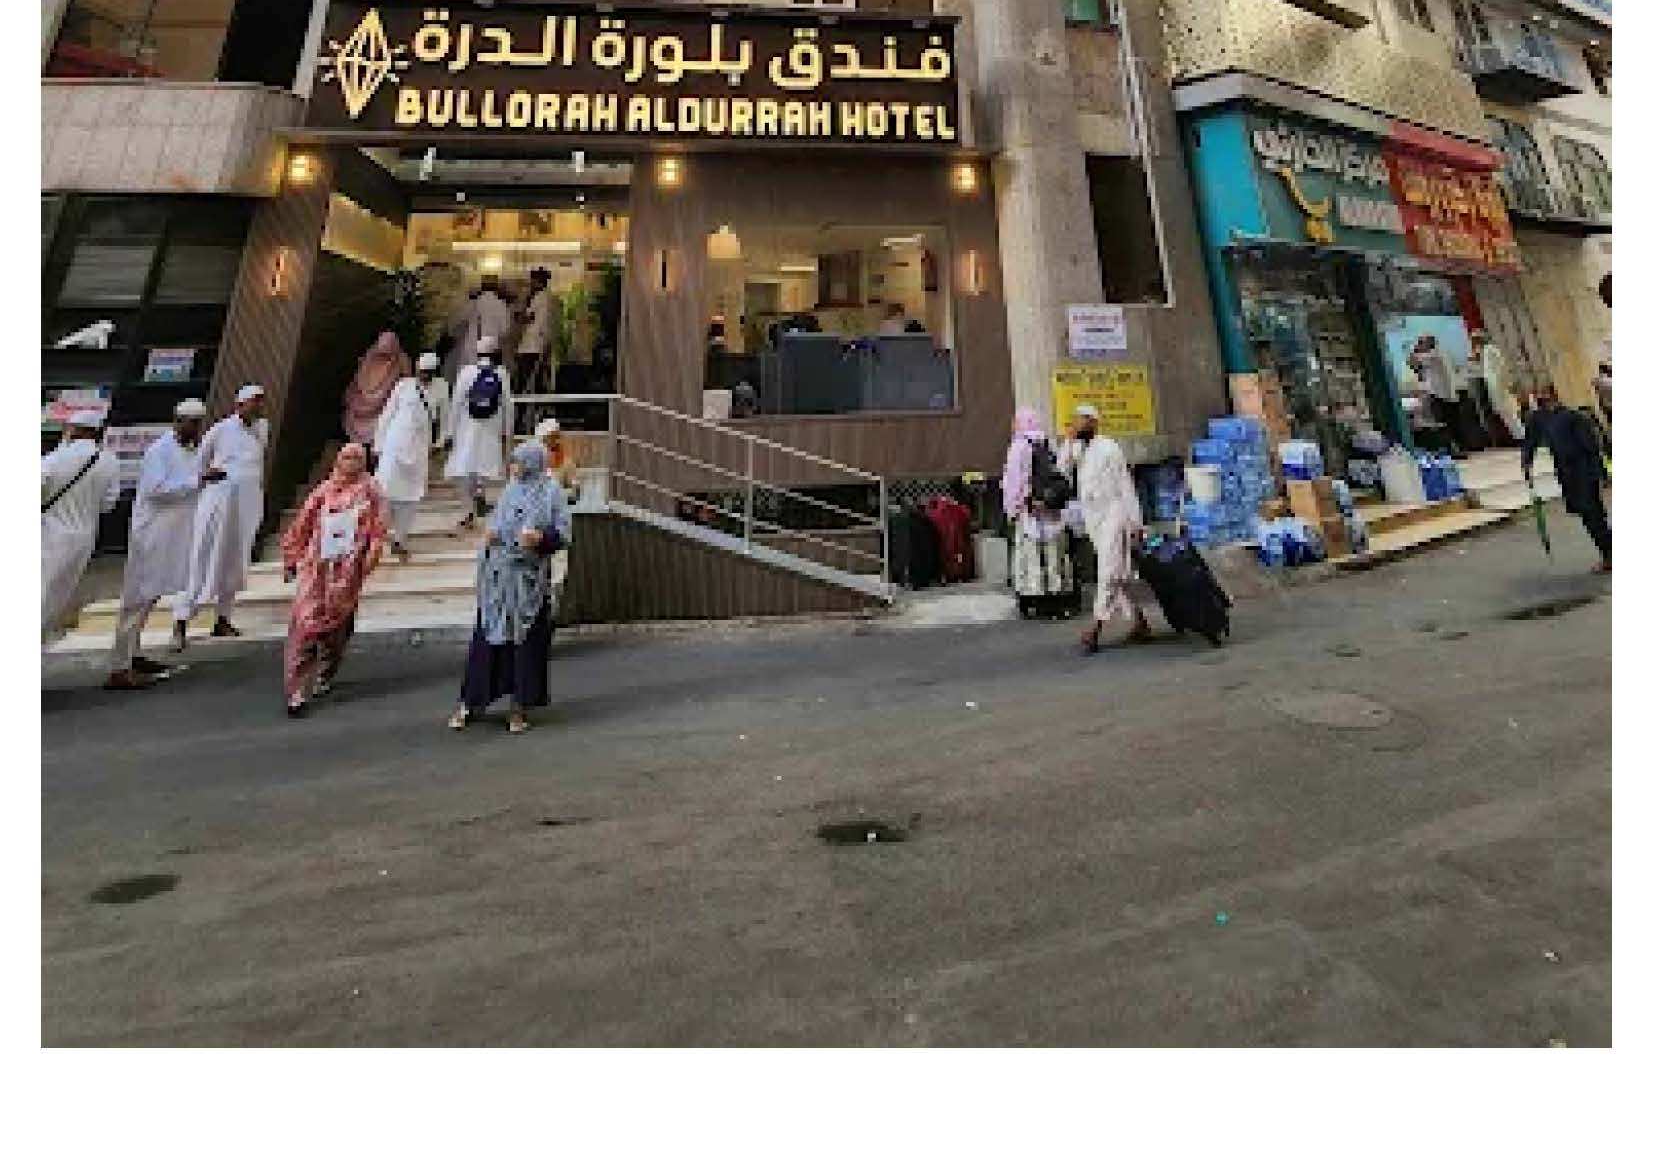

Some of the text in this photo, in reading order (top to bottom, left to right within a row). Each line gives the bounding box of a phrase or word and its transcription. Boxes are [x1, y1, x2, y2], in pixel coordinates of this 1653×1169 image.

[414, 8, 951, 90] فندق بلورة الدرة
[395, 89, 955, 140] BULLORAH ALDURRAH HOTEL
